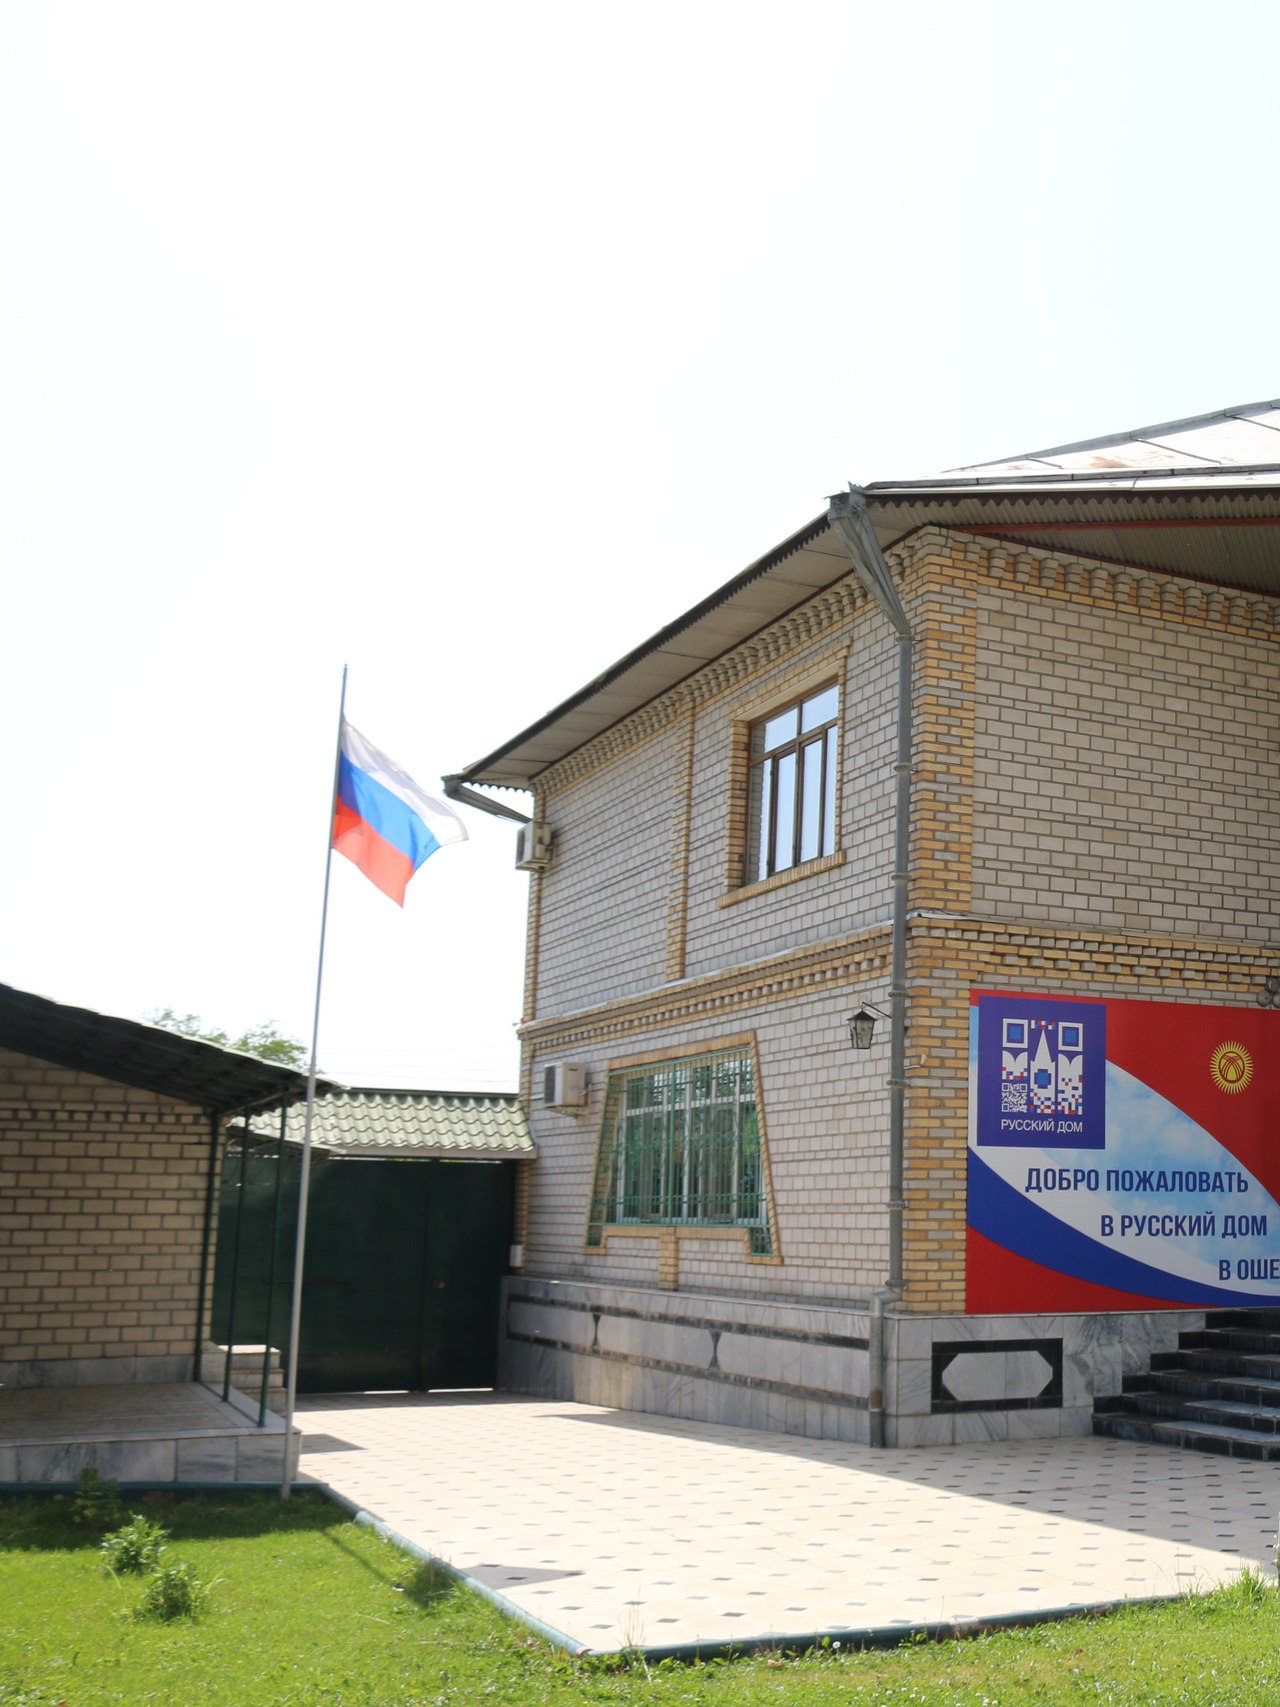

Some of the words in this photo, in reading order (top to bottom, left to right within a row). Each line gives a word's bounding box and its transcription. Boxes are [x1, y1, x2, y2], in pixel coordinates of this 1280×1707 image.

[1001, 1118, 1054, 1131] РУССКИЙ
[1057, 1121, 1083, 1133] ДОМ
[1025, 1168, 1099, 1193] ДОБРО
[1106, 1169, 1249, 1193] ПОЖАЛОВАТЬ
[1101, 1215, 1114, 1237] В
[1120, 1211, 1216, 1237] РУССКИЙ
[1221, 1215, 1268, 1239] ДОМ
[1219, 1259, 1231, 1281] В
[1237, 1258, 1280, 1280] ОШЕ
